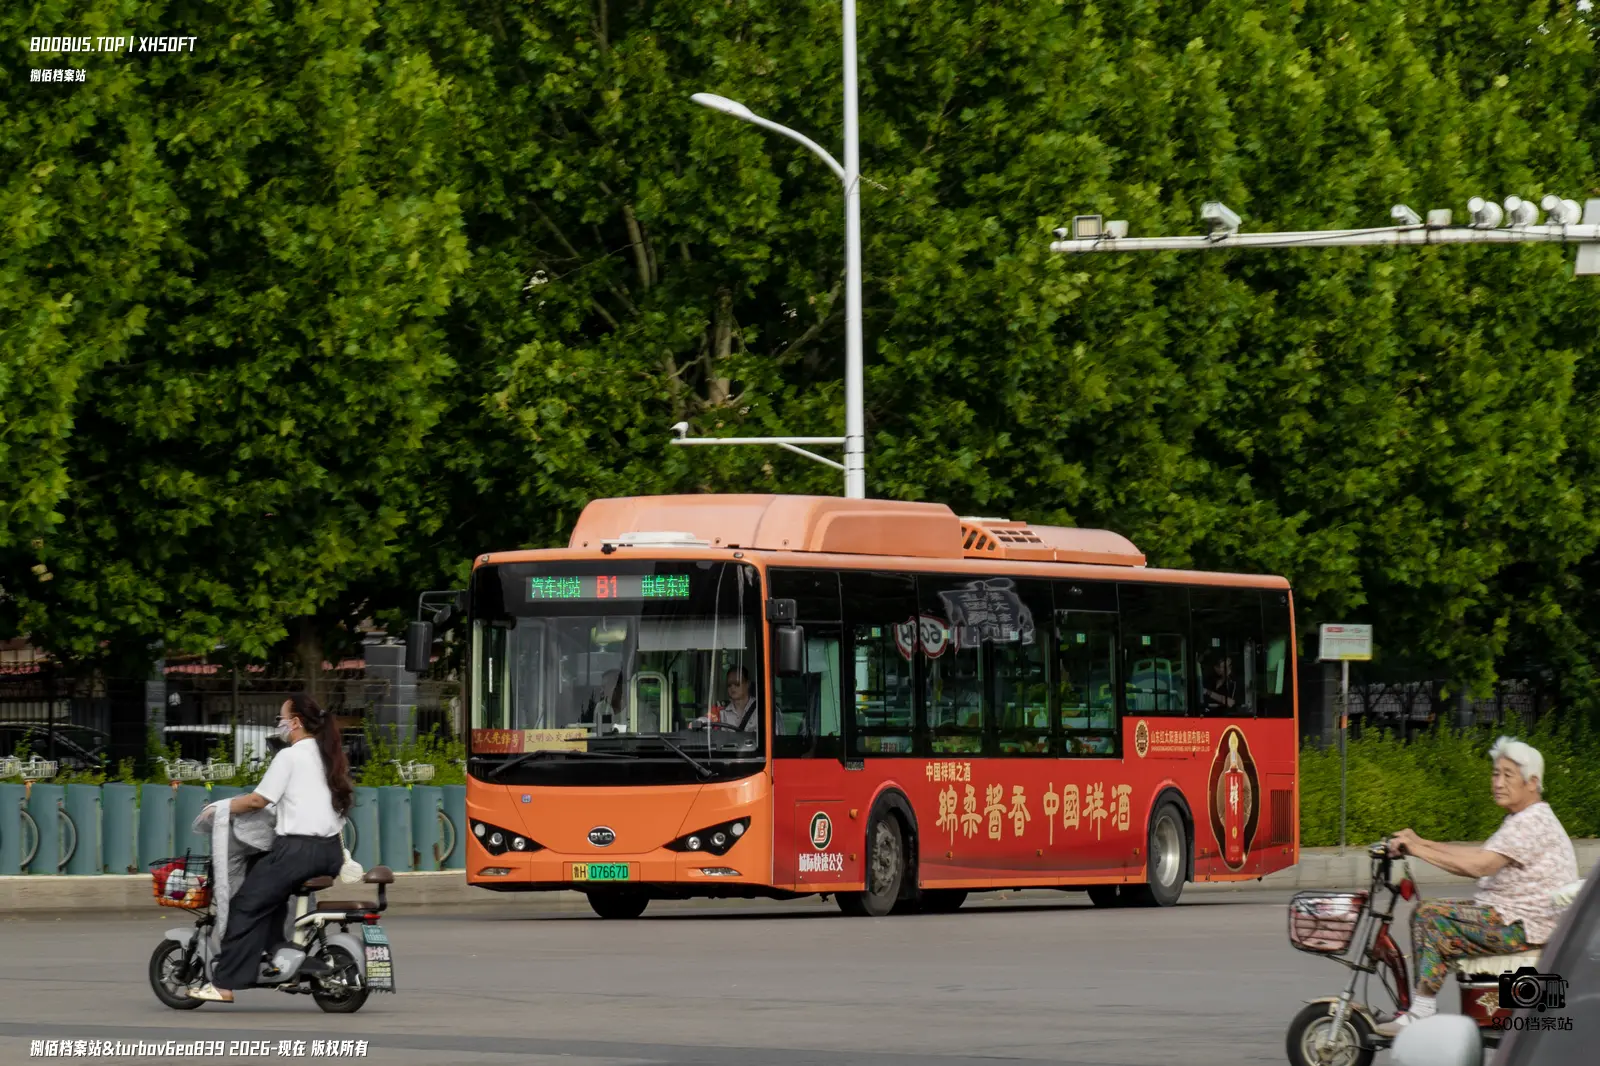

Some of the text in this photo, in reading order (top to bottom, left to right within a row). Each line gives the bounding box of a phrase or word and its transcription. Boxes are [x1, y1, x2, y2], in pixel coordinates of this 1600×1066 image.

[531, 574, 689, 598] 汽车北站 B1 曲阜东站
[926, 762, 971, 782] 中国祥瑞之酒
[590, 832, 613, 841] BYD
[590, 865, 629, 879] 07667D
